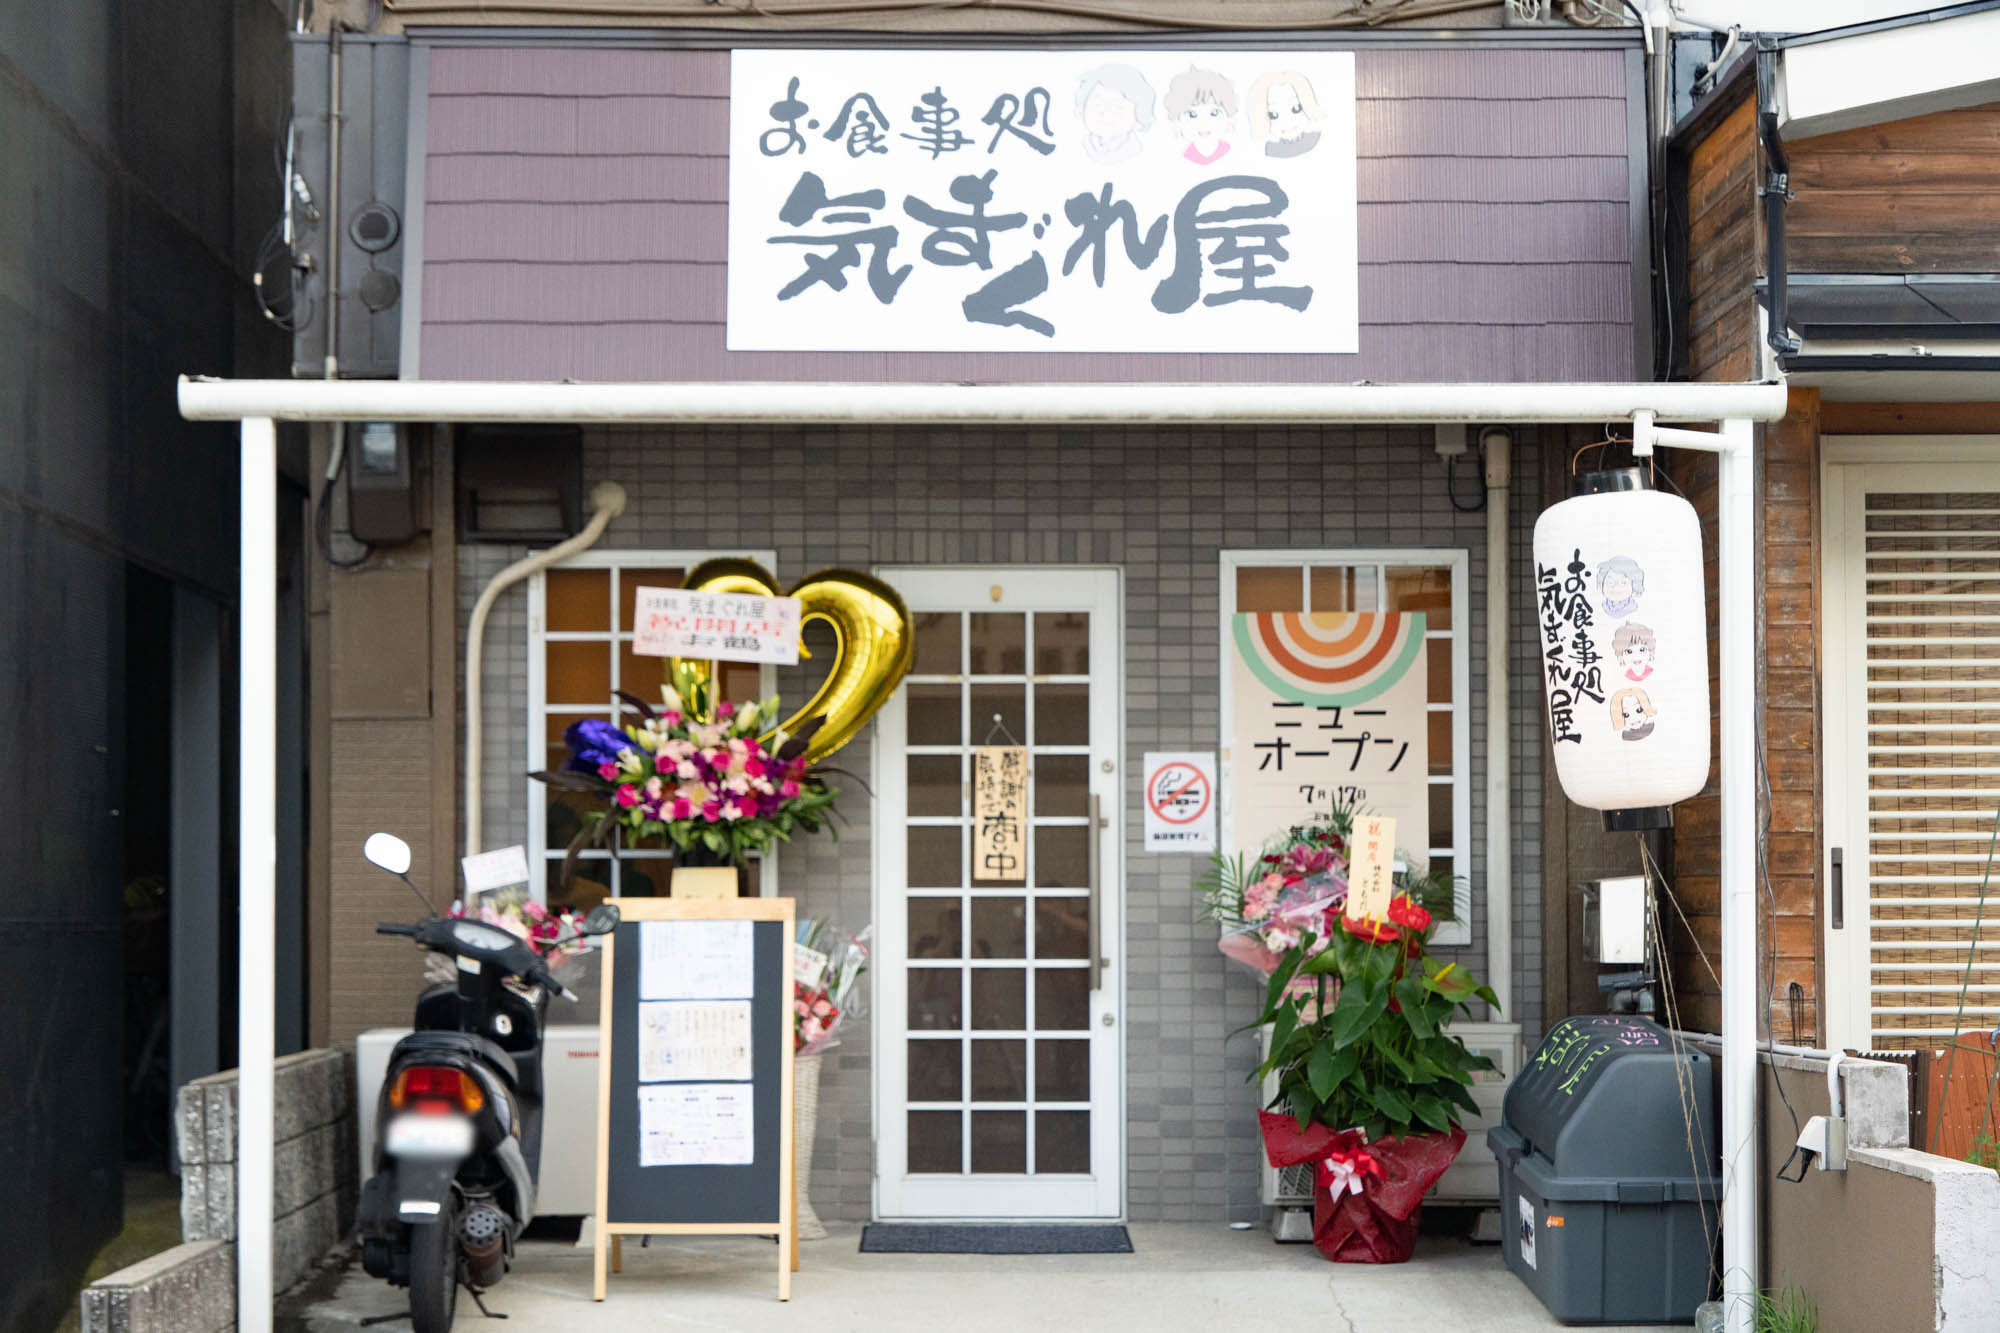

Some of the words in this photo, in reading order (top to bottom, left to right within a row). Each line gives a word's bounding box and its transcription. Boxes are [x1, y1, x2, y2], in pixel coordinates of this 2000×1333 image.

[760, 76, 1057, 159] お食事処
[767, 169, 1314, 338] 気まぐれ屋
[1538, 562, 1582, 745] 気まぐれ屋
[1564, 548, 1606, 704] お食事処
[1254, 731, 1409, 772] オープン
[1272, 702, 1387, 729] ニュー
